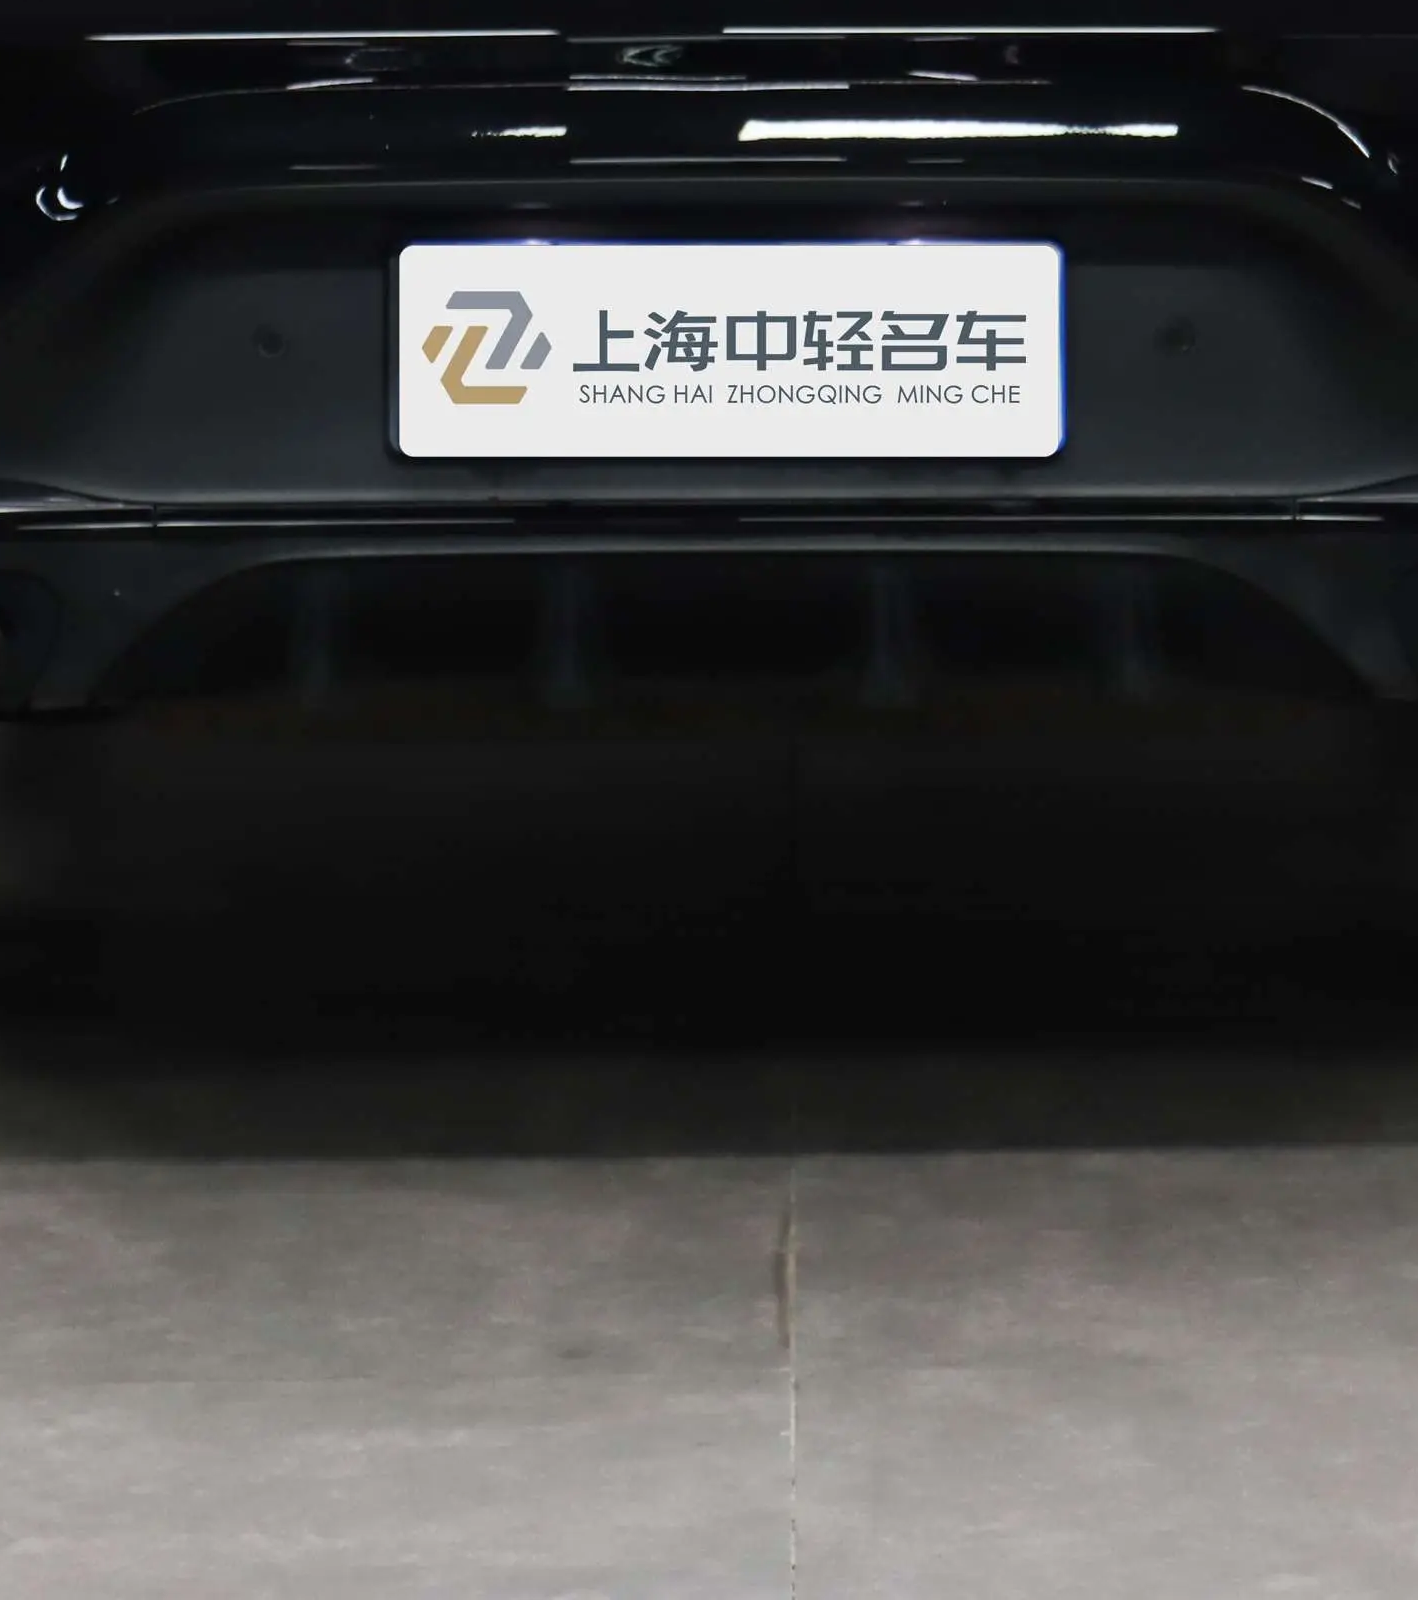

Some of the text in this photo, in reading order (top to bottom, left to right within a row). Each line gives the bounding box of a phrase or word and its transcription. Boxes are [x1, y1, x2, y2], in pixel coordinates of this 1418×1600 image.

[572, 309, 1027, 373] 上海中轻名车
[579, 384, 1021, 405] SHANG HAI ZHONGQING MING CHE
